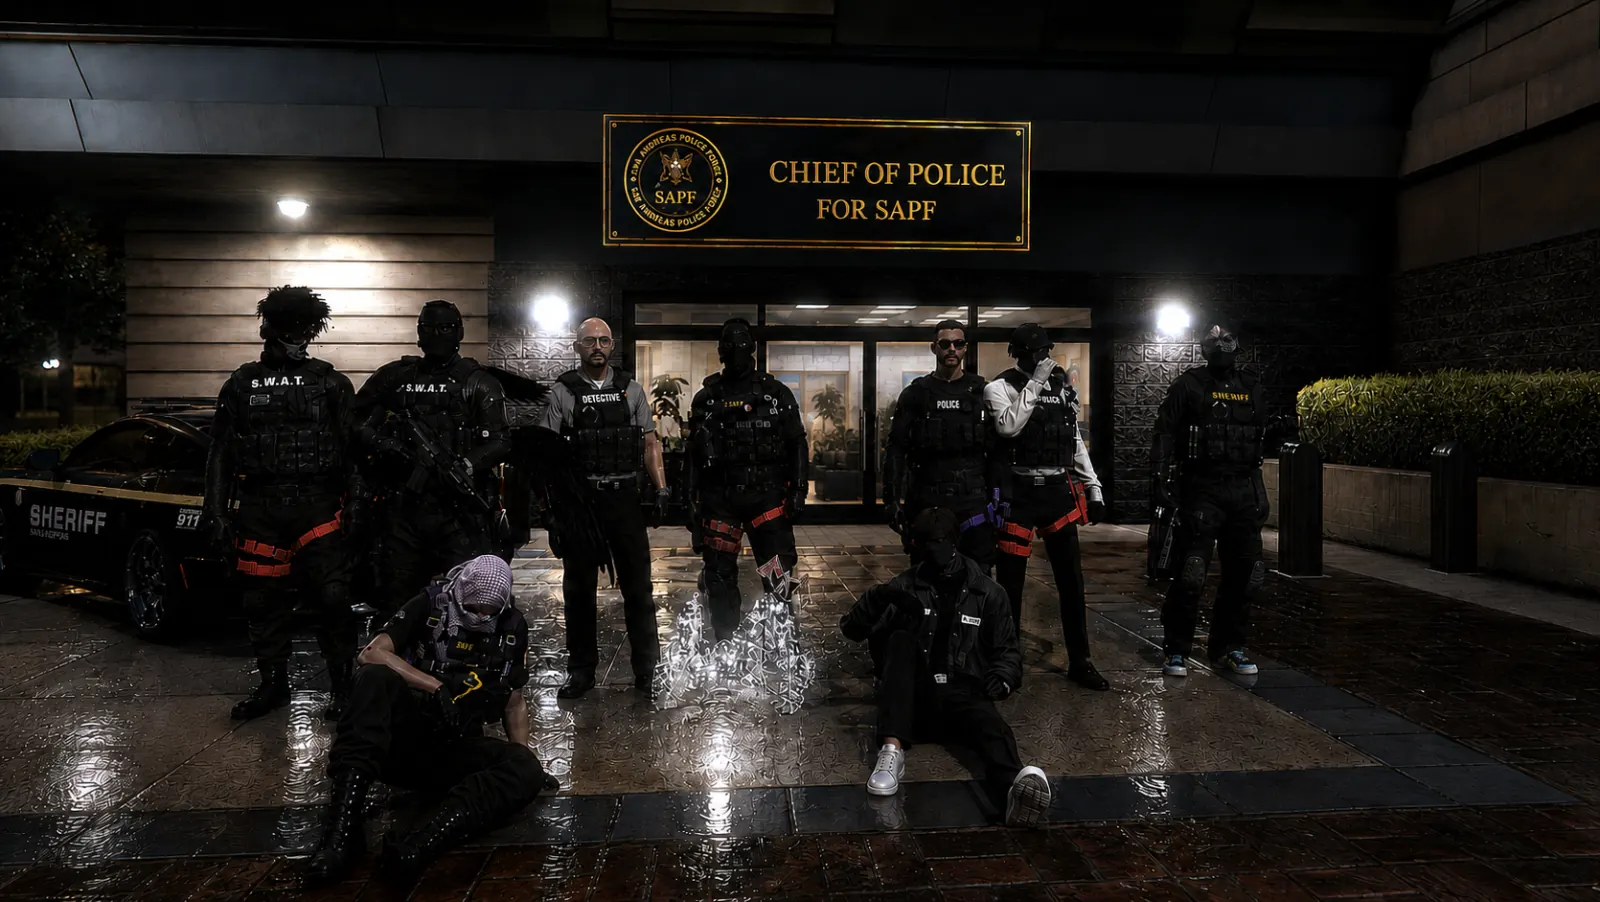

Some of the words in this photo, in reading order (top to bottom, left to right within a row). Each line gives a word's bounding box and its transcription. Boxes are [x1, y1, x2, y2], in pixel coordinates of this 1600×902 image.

[679, 133, 708, 152] POLICE
[769, 160, 858, 184] CHIEF
[864, 162, 901, 185] OF
[907, 163, 1007, 186] POLICE
[655, 190, 697, 205] SAPF
[816, 198, 868, 220] FOR
[875, 199, 937, 221] SAPF
[677, 209, 707, 227] POLICE
[251, 375, 305, 388] S.W.A.T.
[405, 383, 448, 393] S.W.A.T.
[582, 392, 621, 404] DETECTIVE
[1212, 391, 1249, 401] SHERIFF
[936, 399, 960, 409] POLICE
[30, 503, 107, 535] SHERIFF
[176, 513, 200, 527] 911
